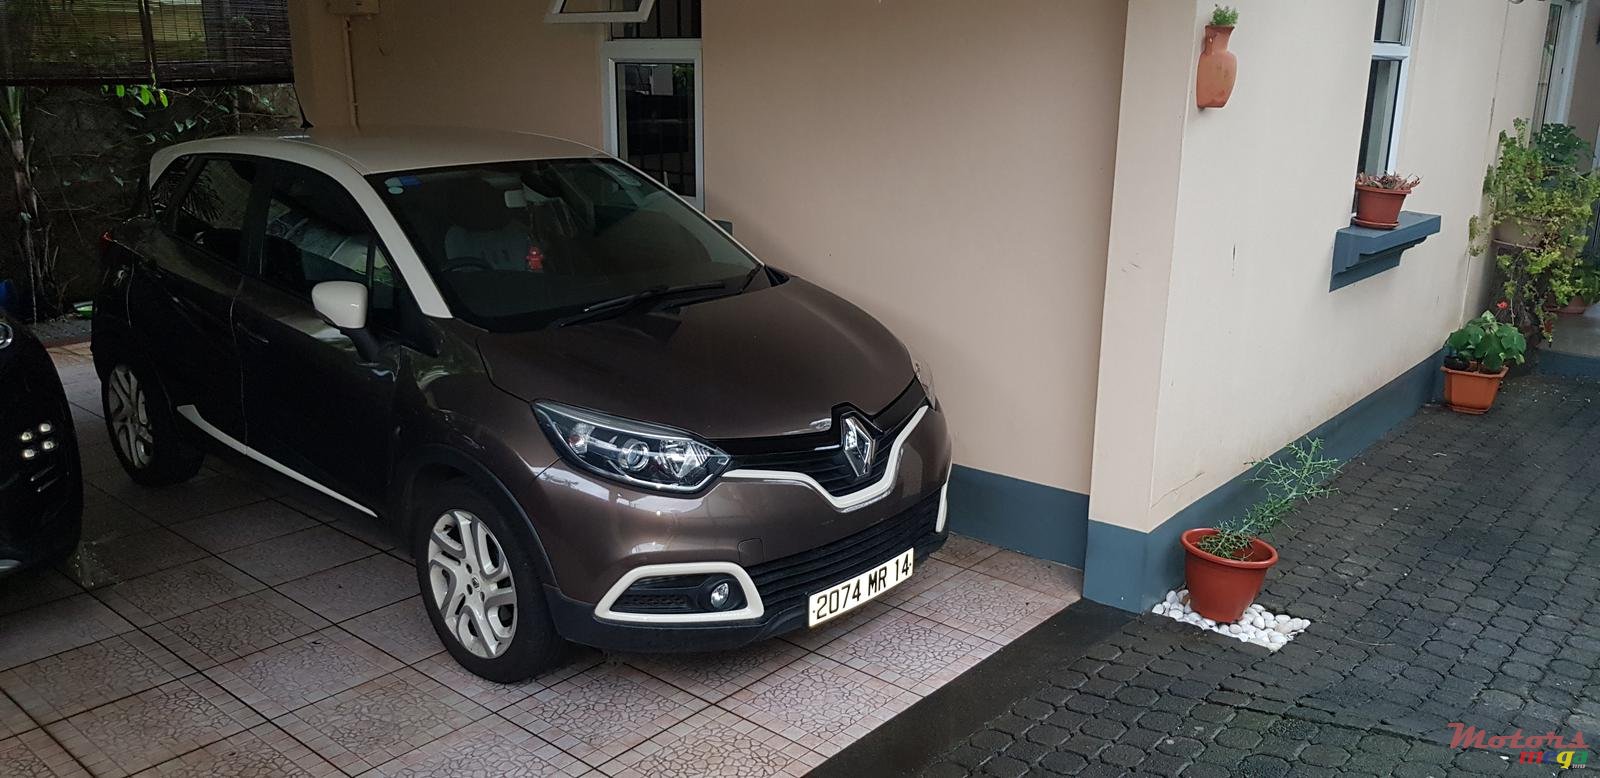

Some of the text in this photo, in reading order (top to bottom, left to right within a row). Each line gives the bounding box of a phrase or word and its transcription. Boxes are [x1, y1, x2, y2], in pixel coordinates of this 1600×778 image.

[816, 553, 909, 619] 2074 MR 14
